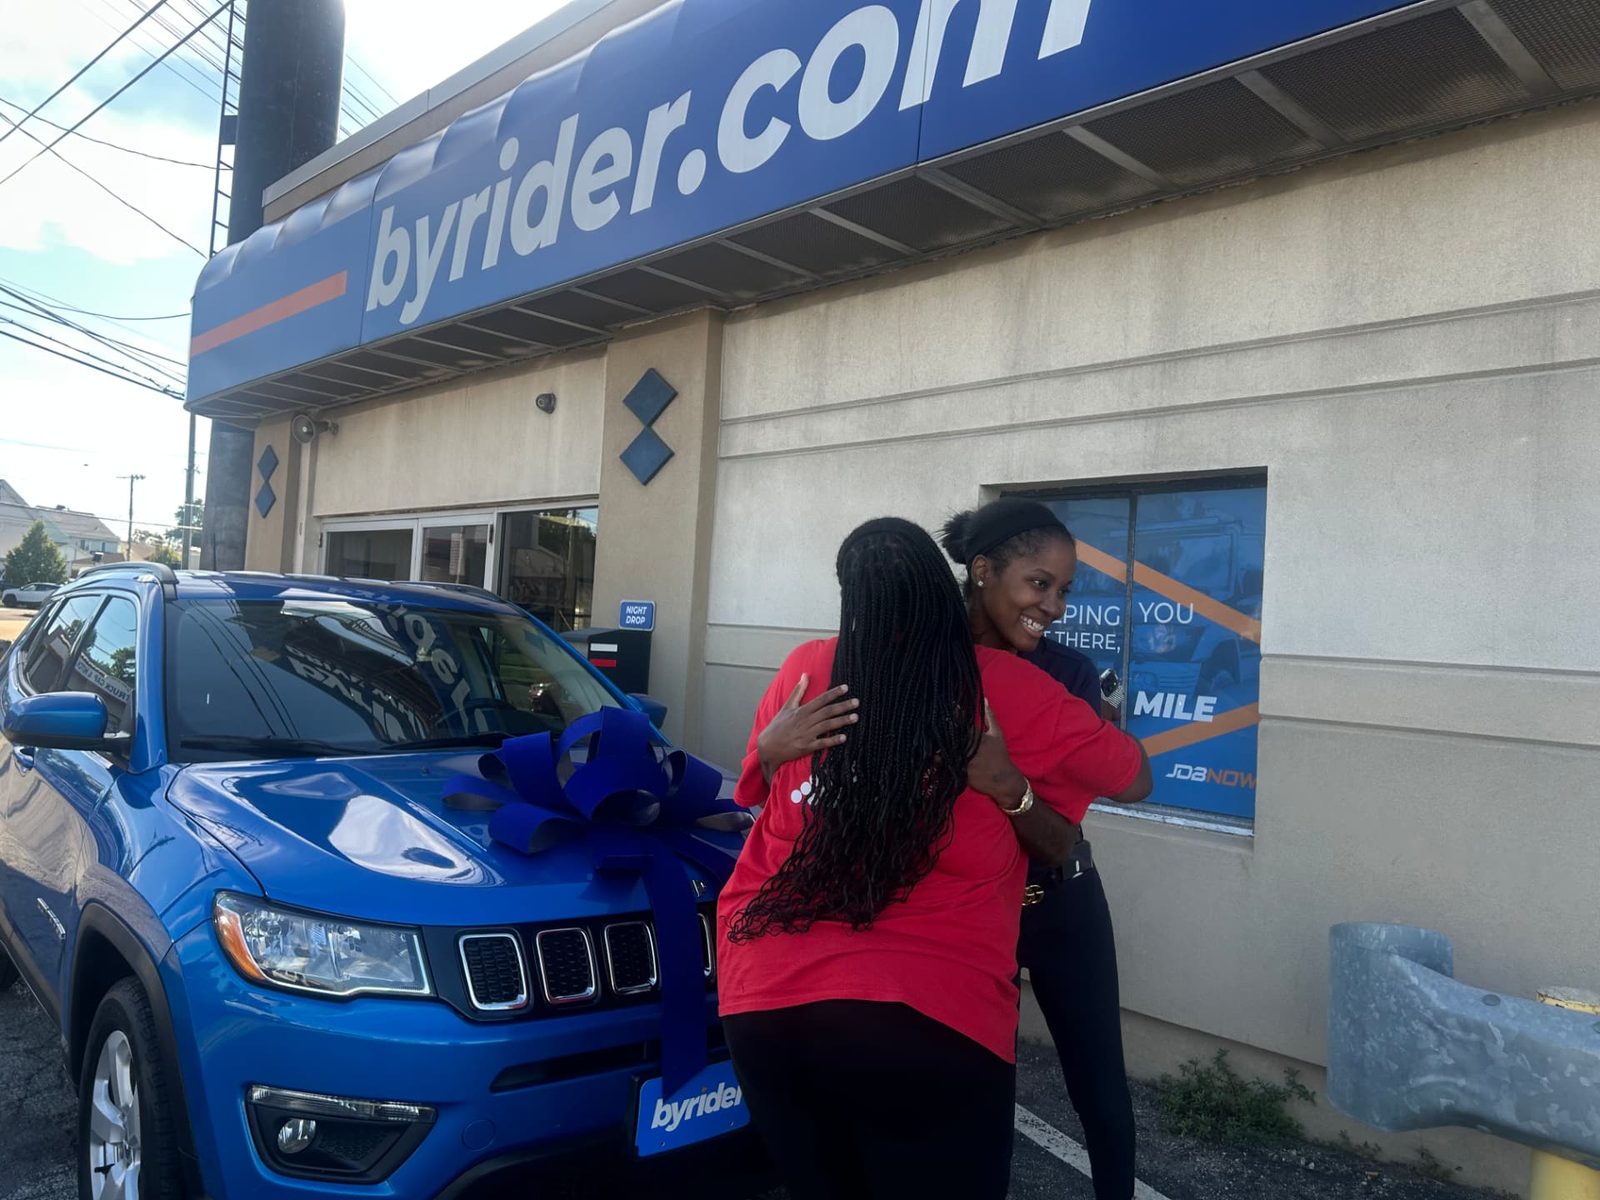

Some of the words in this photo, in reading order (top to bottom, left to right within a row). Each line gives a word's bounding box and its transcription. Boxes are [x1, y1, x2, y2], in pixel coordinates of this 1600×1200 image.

[366, 0, 1091, 325] byrider.com
[626, 606, 647, 614] NIGHT
[626, 616, 646, 624] DROP
[1052, 603, 1121, 626] PING
[1138, 602, 1194, 624] YOU
[1055, 631, 1121, 653] THERE,
[1133, 690, 1217, 722] MILE
